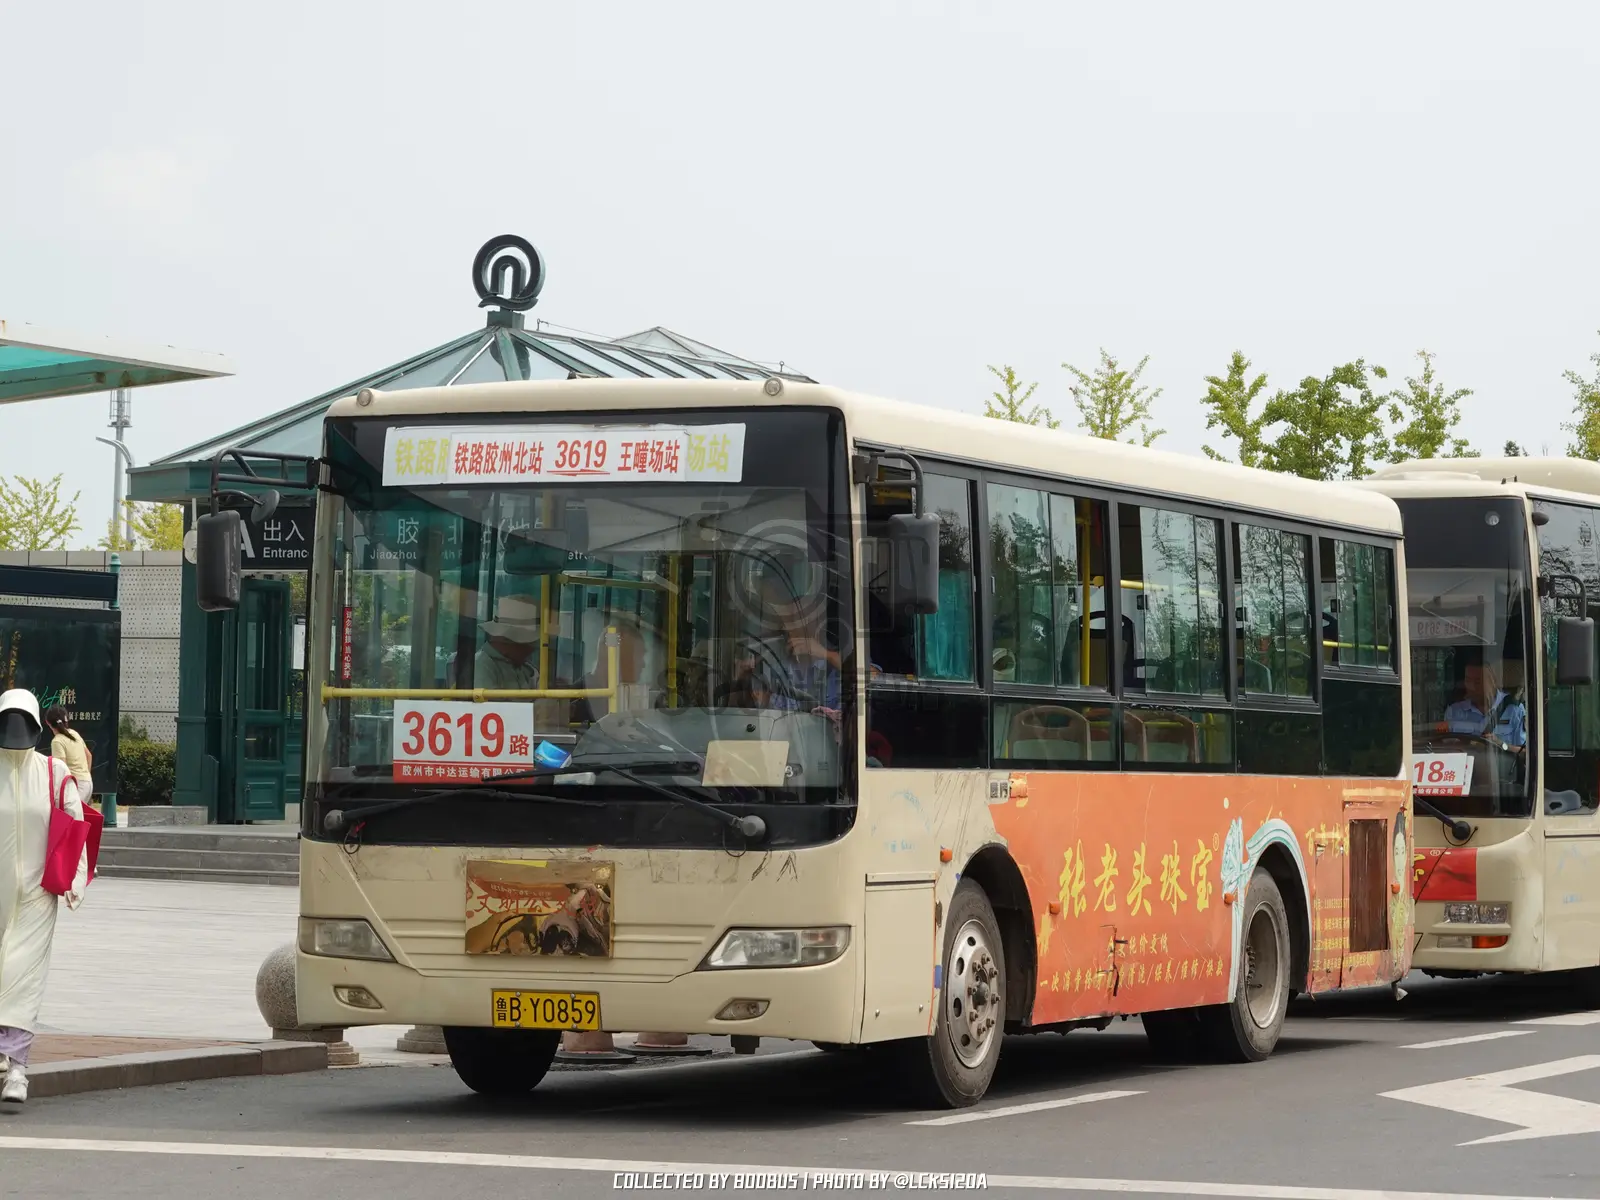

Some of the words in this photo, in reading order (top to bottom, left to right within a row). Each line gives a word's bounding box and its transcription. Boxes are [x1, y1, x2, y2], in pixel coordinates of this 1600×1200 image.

[454, 441, 544, 475] 铁路胶州北站
[555, 439, 607, 468] 3619
[263, 519, 306, 542] 出入
[263, 547, 309, 558] Entranc
[402, 711, 530, 758] 3619路
[1059, 839, 1213, 920] 张老头珠宝
[496, 997, 596, 1024] 鲁B·Y0859
